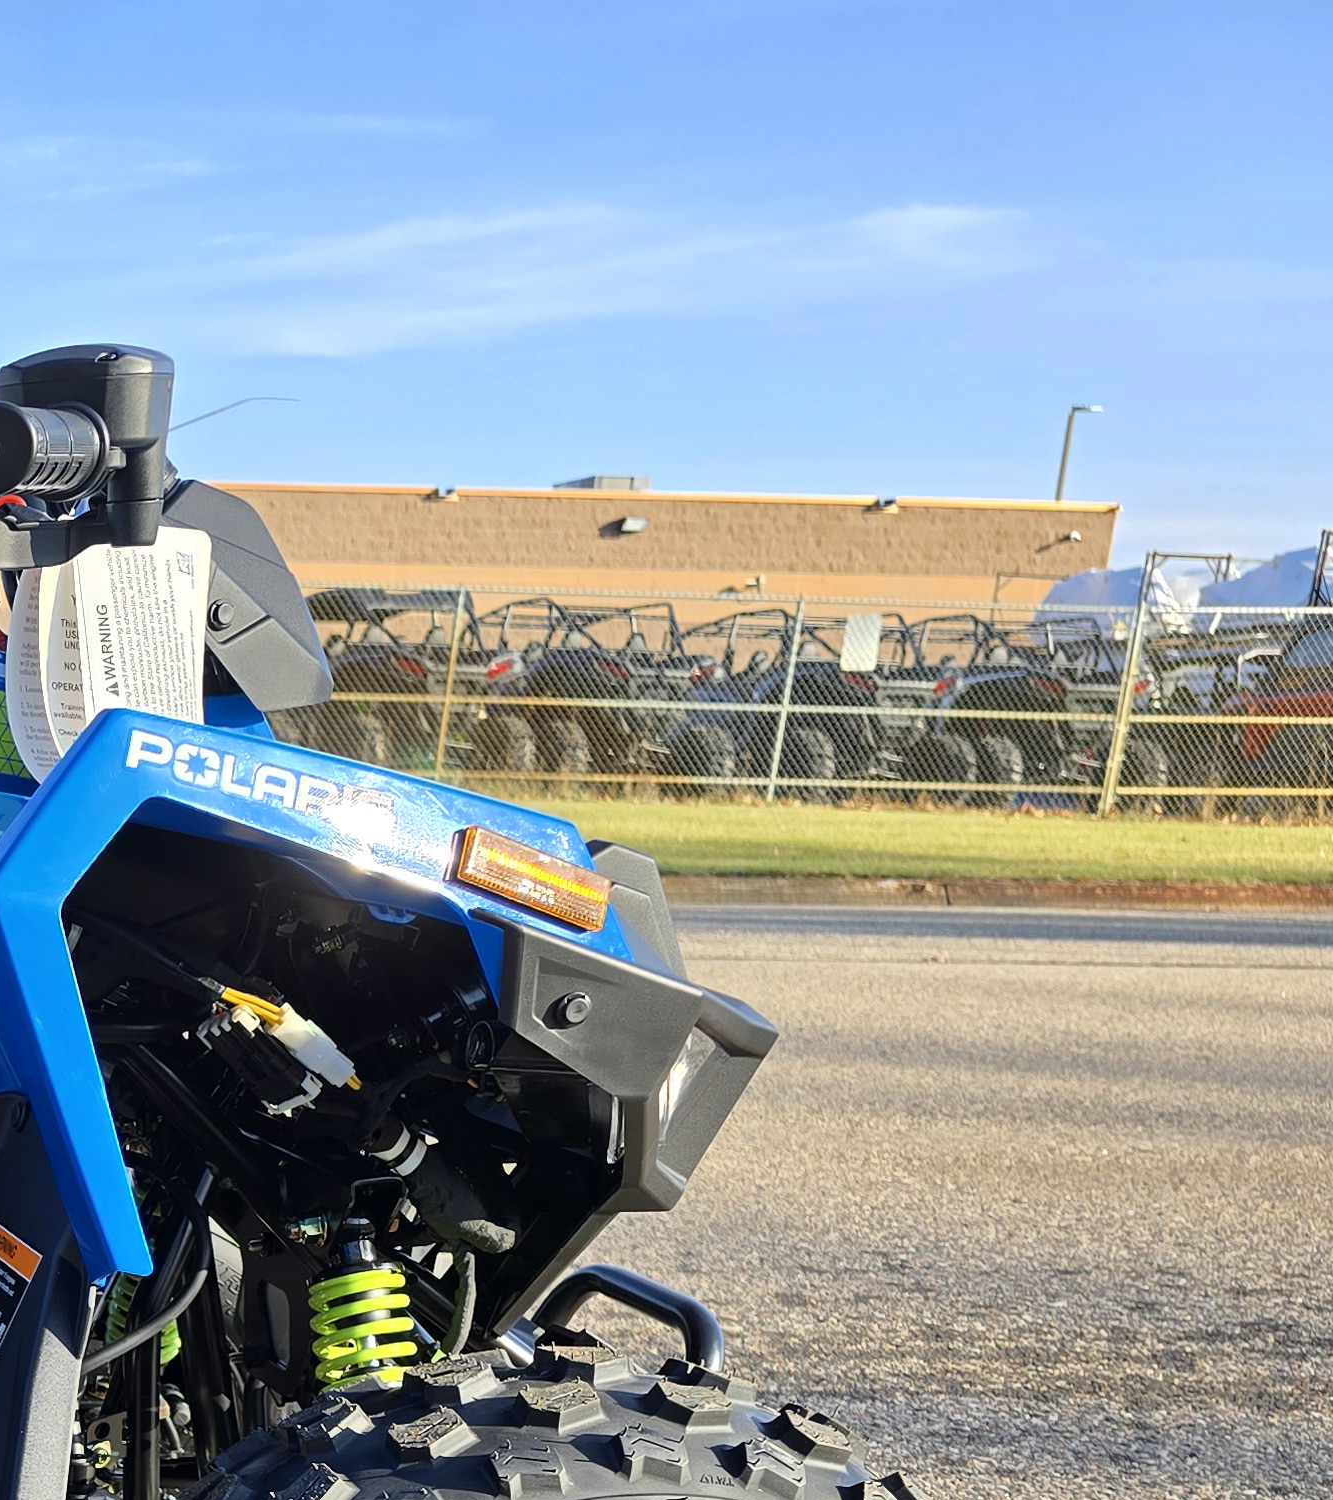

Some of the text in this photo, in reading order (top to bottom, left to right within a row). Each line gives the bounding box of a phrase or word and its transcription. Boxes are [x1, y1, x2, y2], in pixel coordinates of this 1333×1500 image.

[110, 578, 121, 618] passenger
[60, 618, 77, 628] This
[96, 604, 116, 680] WARNING
[64, 661, 77, 671] NO
[117, 628, 127, 672] maintaining
[125, 729, 397, 838] POLAR
